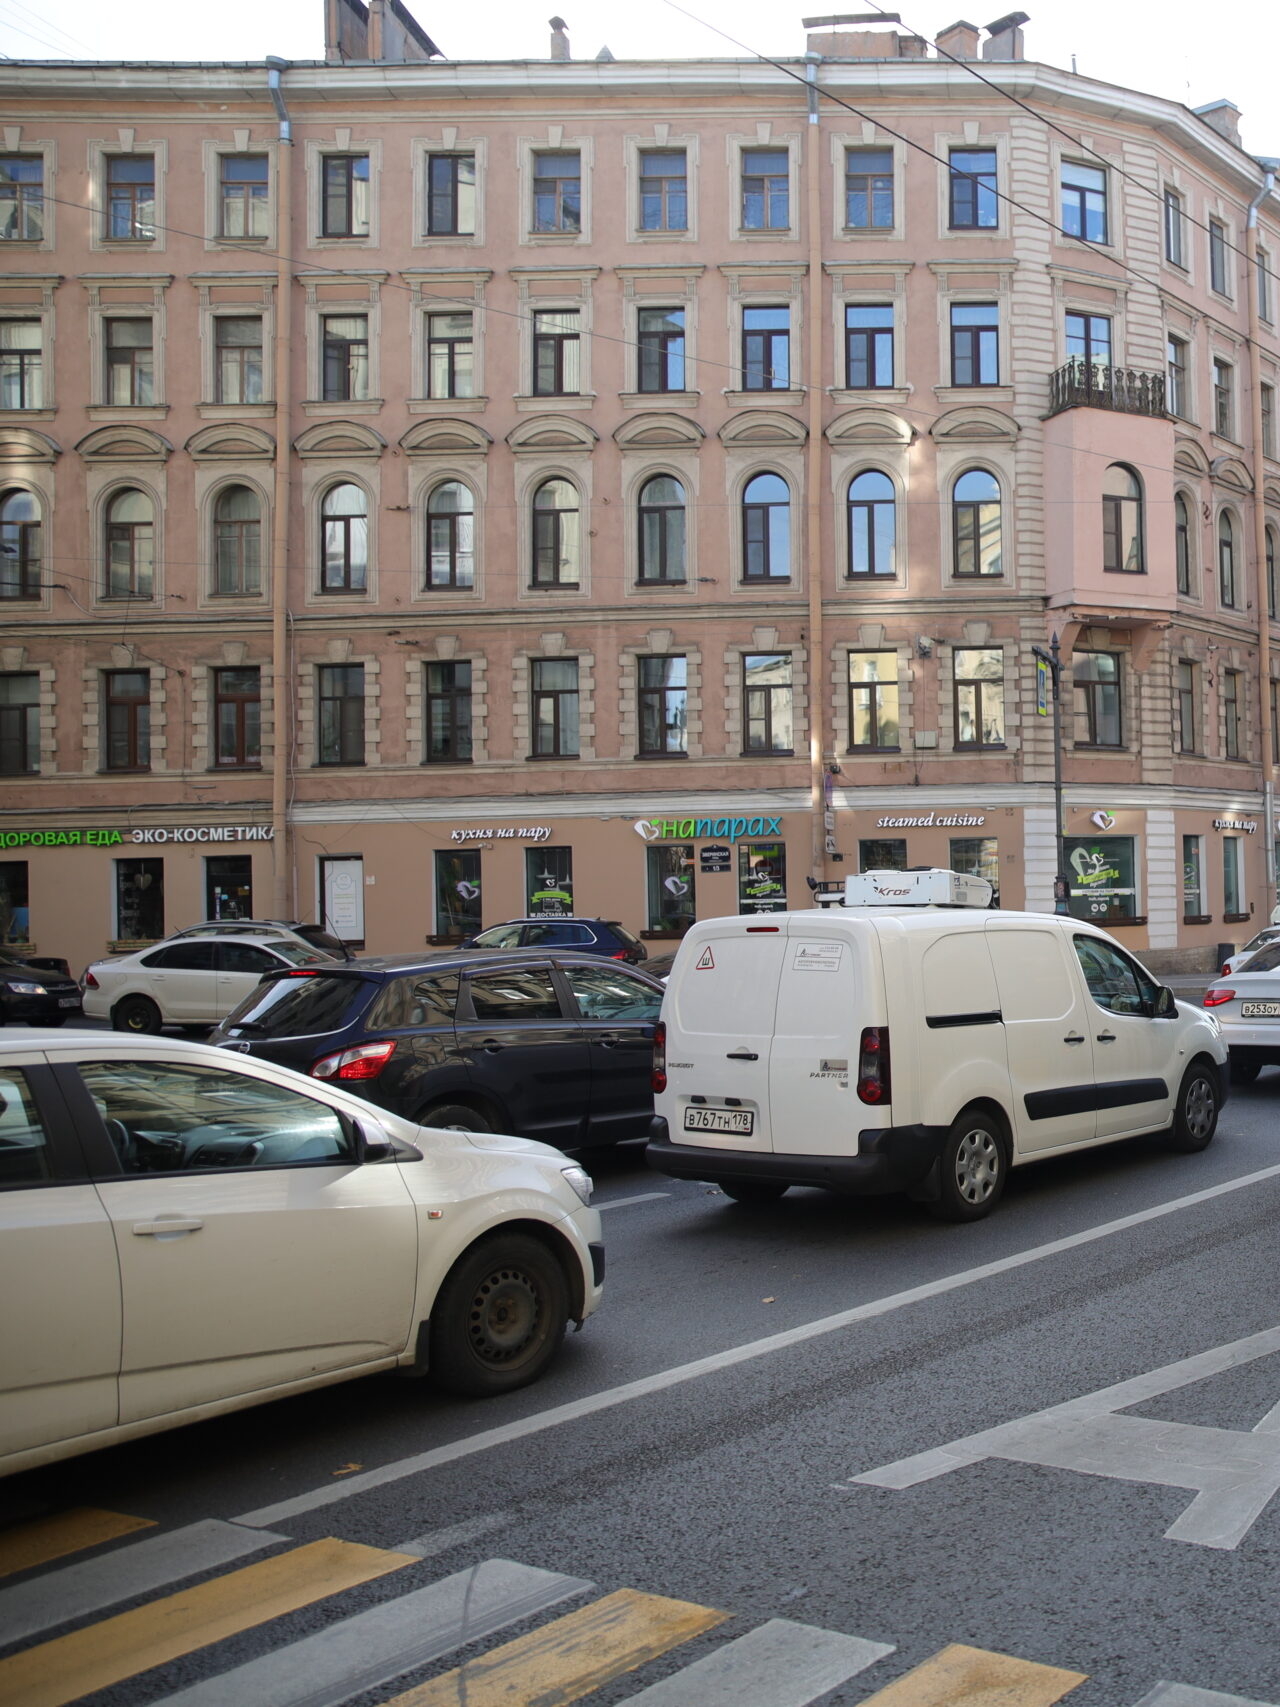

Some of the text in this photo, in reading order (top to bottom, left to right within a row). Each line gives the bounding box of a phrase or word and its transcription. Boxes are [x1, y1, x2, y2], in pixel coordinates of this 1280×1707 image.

[877, 812, 985, 828] steamed cuisine
[1215, 818, 1258, 834] кухня на пару
[86, 829, 123, 847] ЕДА
[451, 826, 552, 843] кухня на пару
[878, 887, 911, 896] Kros
[701, 957, 710, 966] Ш
[689, 1111, 749, 1129] В767ТН 178
